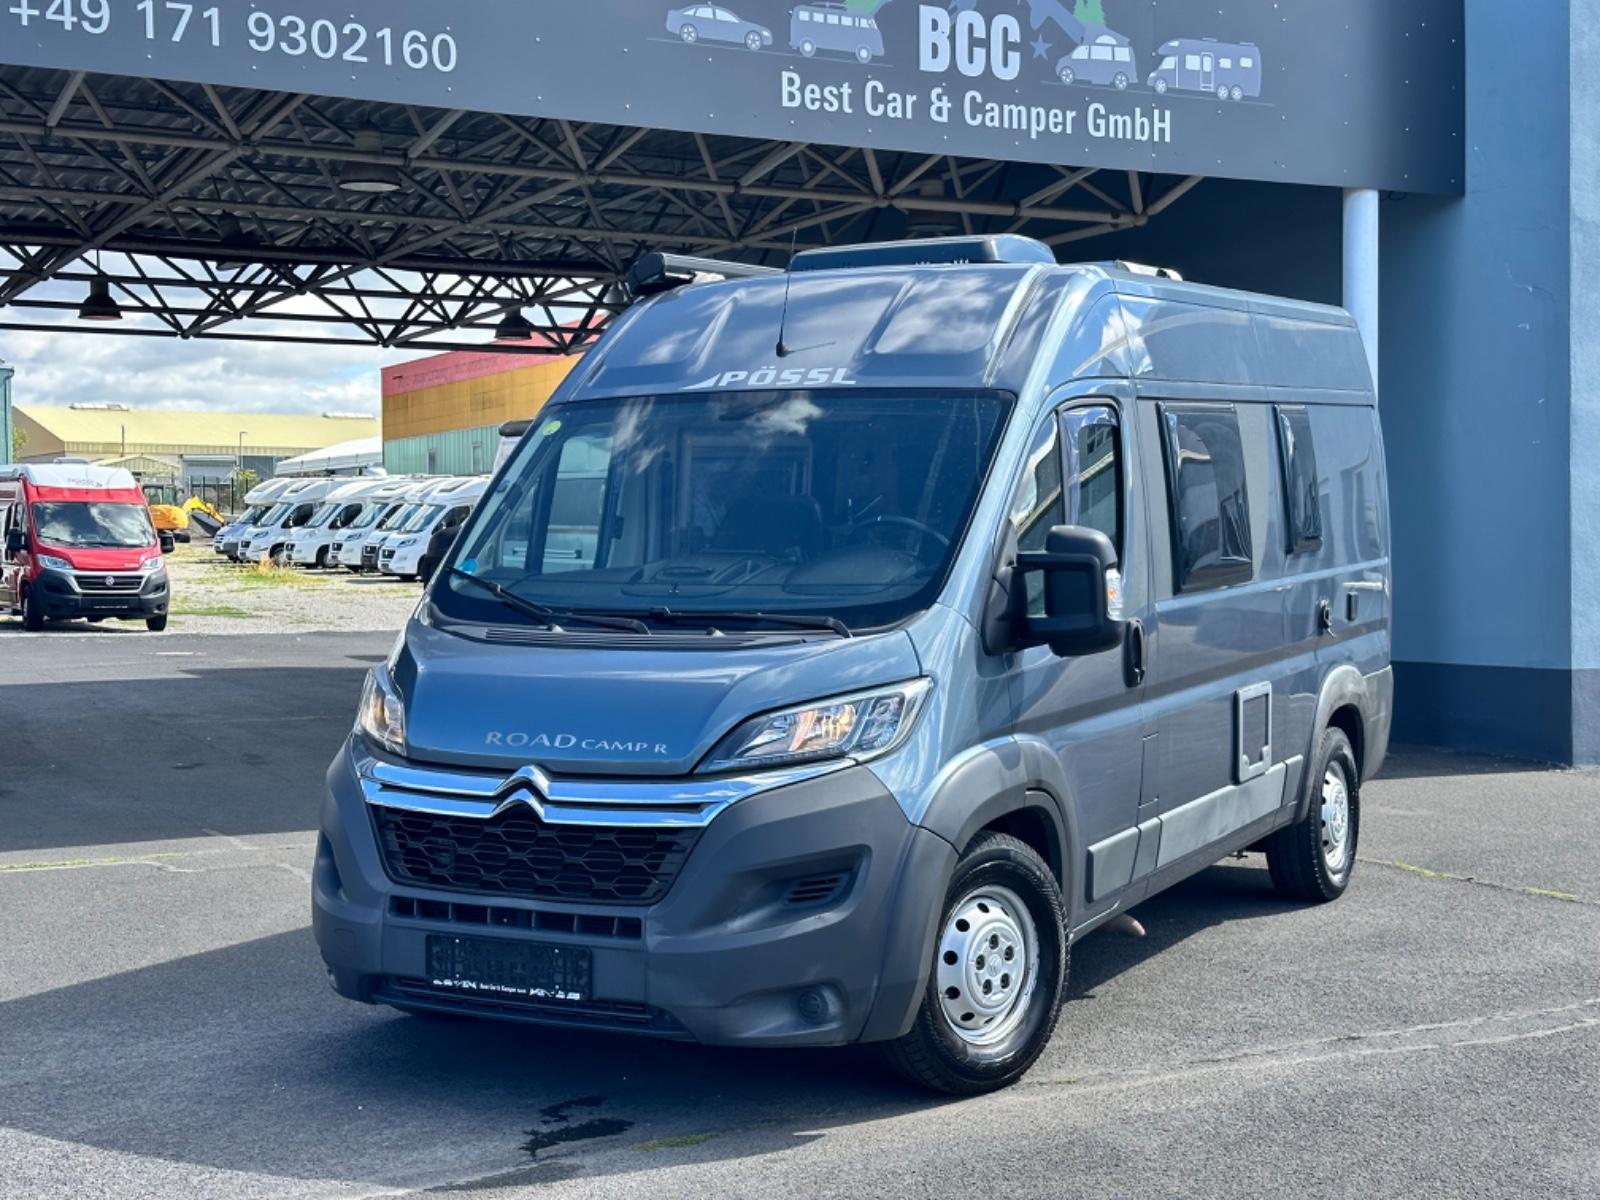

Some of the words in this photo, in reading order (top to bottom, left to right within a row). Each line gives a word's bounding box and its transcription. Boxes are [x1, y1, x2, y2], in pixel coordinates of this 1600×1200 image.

[9, 0, 110, 34] +49
[137, 0, 221, 46] 171
[247, 11, 457, 72] 9302160
[920, 5, 1021, 80] BCC
[781, 71, 852, 115] Best
[864, 80, 917, 121] Car
[930, 87, 952, 123] &
[963, 90, 1076, 139] Camper
[1088, 103, 1172, 143] GmbH
[718, 366, 856, 387] PÖSSL
[485, 731, 577, 748] ROAD
[582, 739, 647, 751] CAMP
[654, 743, 668, 754] R
